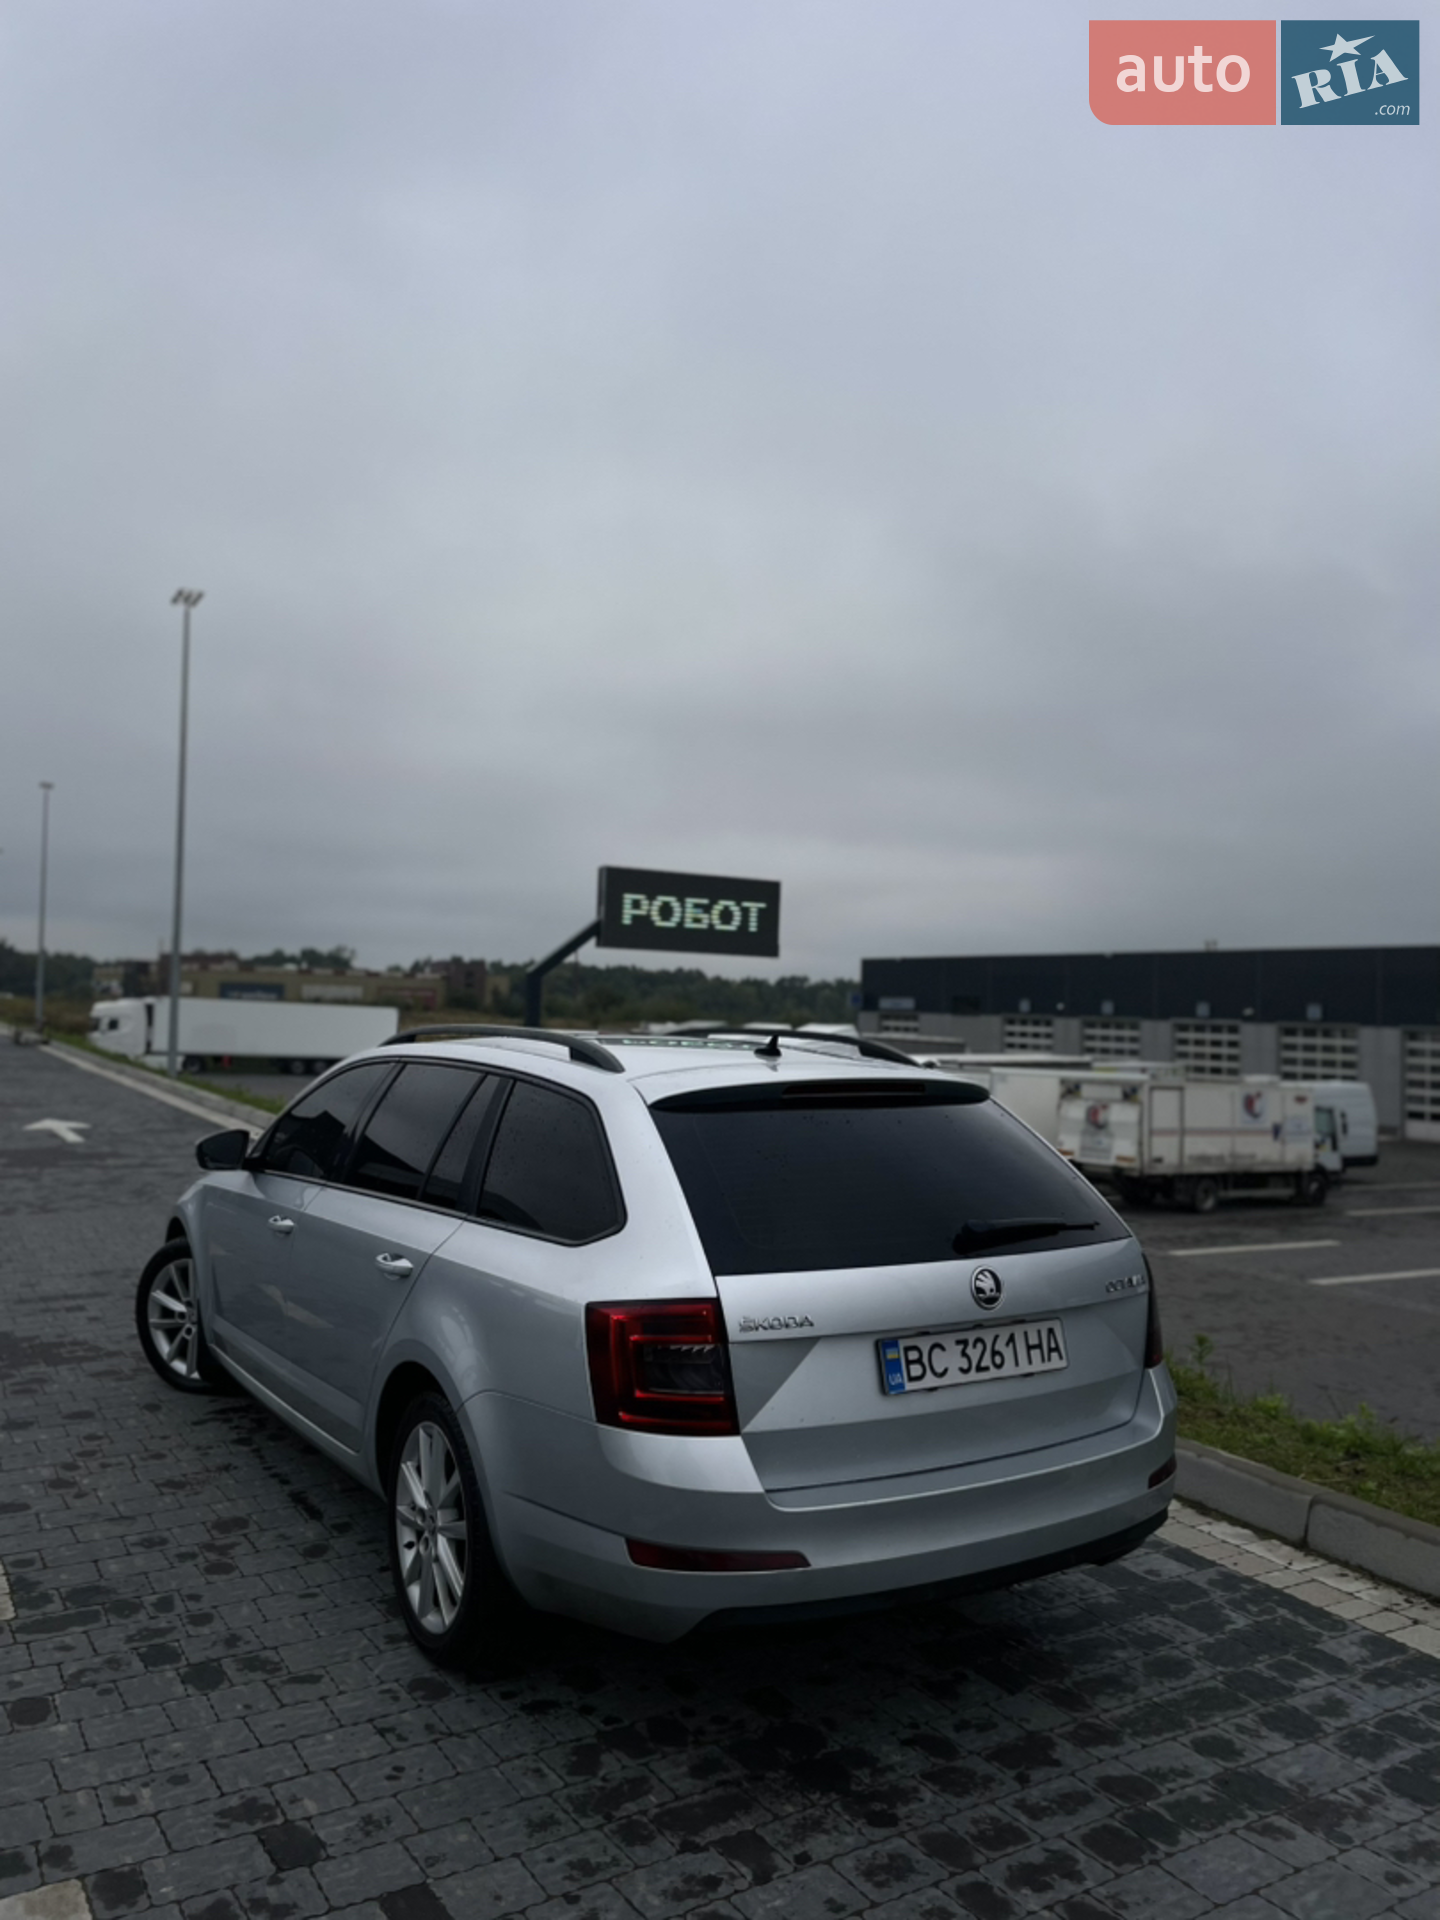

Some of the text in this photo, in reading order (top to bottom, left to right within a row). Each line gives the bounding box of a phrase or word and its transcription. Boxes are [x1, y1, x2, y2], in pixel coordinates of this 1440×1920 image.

[621, 892, 767, 932] РОБОТ
[903, 1327, 1064, 1383] BC 3261 HA
